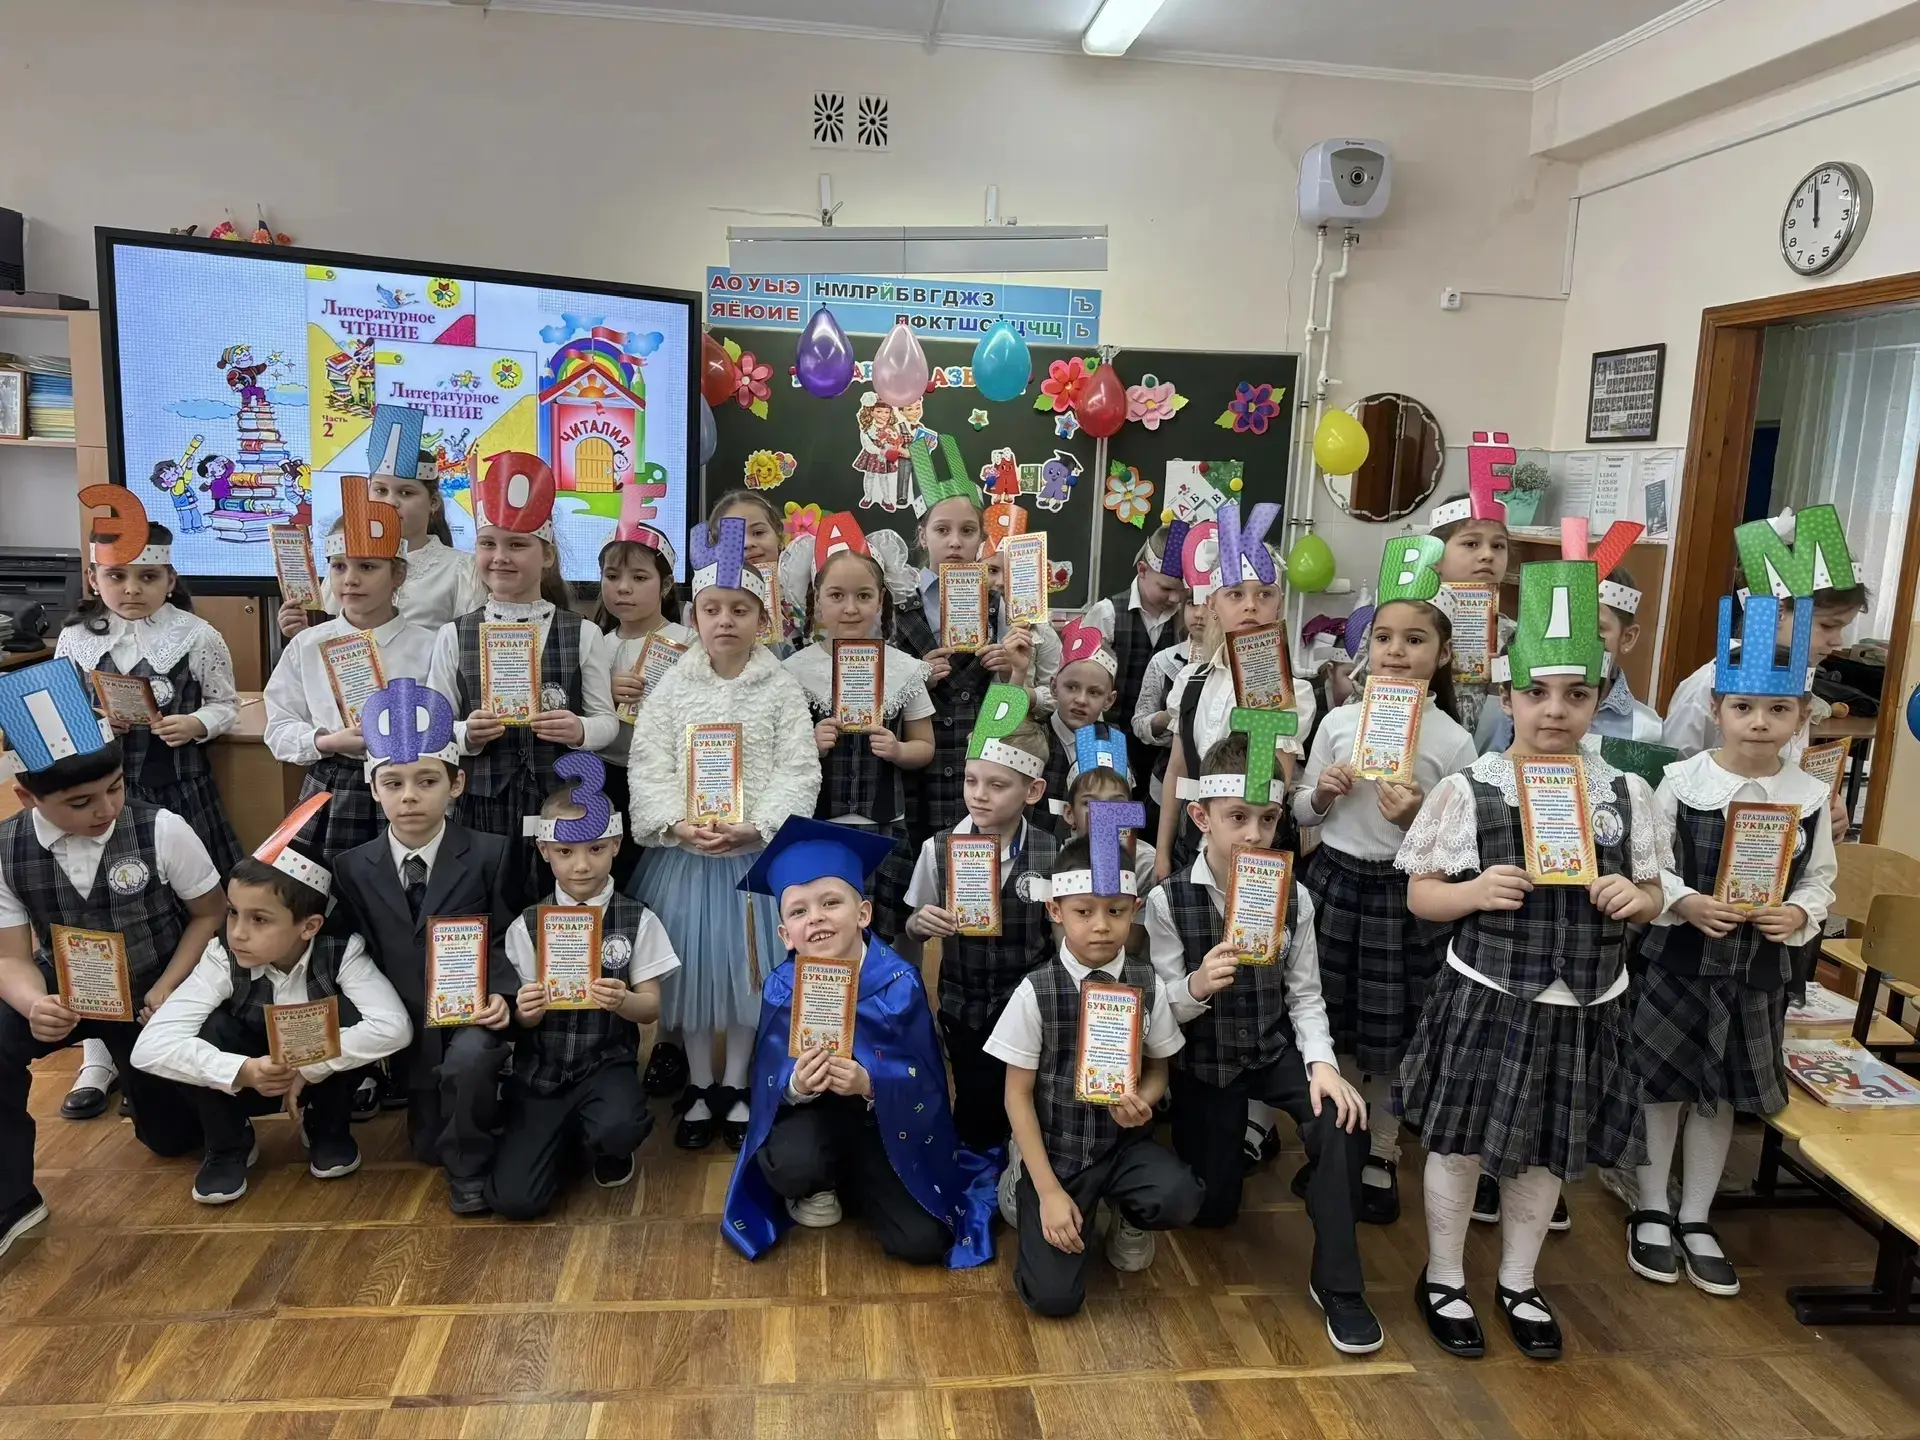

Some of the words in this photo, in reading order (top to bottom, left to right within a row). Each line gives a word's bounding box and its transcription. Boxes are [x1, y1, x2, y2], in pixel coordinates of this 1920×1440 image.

[1807, 184, 1813, 194] 11
[1820, 174, 1830, 185] 12
[1796, 198, 1804, 208] 10
[1788, 219, 1796, 229] 9
[1841, 209, 1850, 220] 3
[1789, 238, 1797, 247] 8
[1834, 229, 1841, 240] 4
[1796, 250, 1803, 261] 7
[1807, 255, 1815, 264] 6
[1822, 246, 1830, 257] 5
[815, 281, 995, 307] НМЛРЙБВГДЖЗ
[1075, 298, 1093, 312] Ъ
[322, 299, 435, 324] Литературное
[710, 300, 800, 321] ЯЁЮИЕ
[339, 320, 419, 339] ЧТЕНИЕ
[896, 314, 1062, 338] ПФКТШСЦЧЩ
[390, 381, 499, 406] Литературное
[322, 422, 334, 438] 2
[560, 420, 631, 448] ЧИТАЛИЯ
[367, 404, 426, 479] Л
[1467, 431, 1517, 522] Ё
[470, 449, 557, 533] Ю
[77, 483, 149, 566] Э
[616, 483, 667, 549] Е
[814, 510, 871, 571] А
[1217, 502, 1282, 587] К
[1733, 503, 1857, 598] М
[689, 517, 746, 590] Ч
[1377, 535, 1445, 606] В
[1508, 560, 1605, 691] Д
[1236, 637, 1280, 652] БУКВАРЯ!
[1715, 595, 1815, 697] Ш
[1371, 693, 1417, 703] БУКВАРЯ!
[0, 657, 105, 773] П
[361, 678, 454, 764] Ф
[966, 682, 1031, 760] Р
[1074, 724, 1128, 781] Н
[1229, 707, 1298, 805] Т
[1525, 776, 1577, 785] БУКВАРЯ!
[552, 750, 611, 845] З
[1735, 822, 1789, 831] БУКВАРЯ!
[1089, 801, 1146, 897] Г
[1237, 865, 1284, 878] БУКВАРЯ!
[1243, 857, 1285, 868] ПРАЗДНИКОМ
[435, 933, 482, 942] БУКВАРЯ!
[802, 974, 850, 983] БУКВАРЯ!
[1087, 1001, 1136, 1013] БУКВАРЯ!
[1092, 994, 1136, 1003] ПРАЗДНИКОМ
